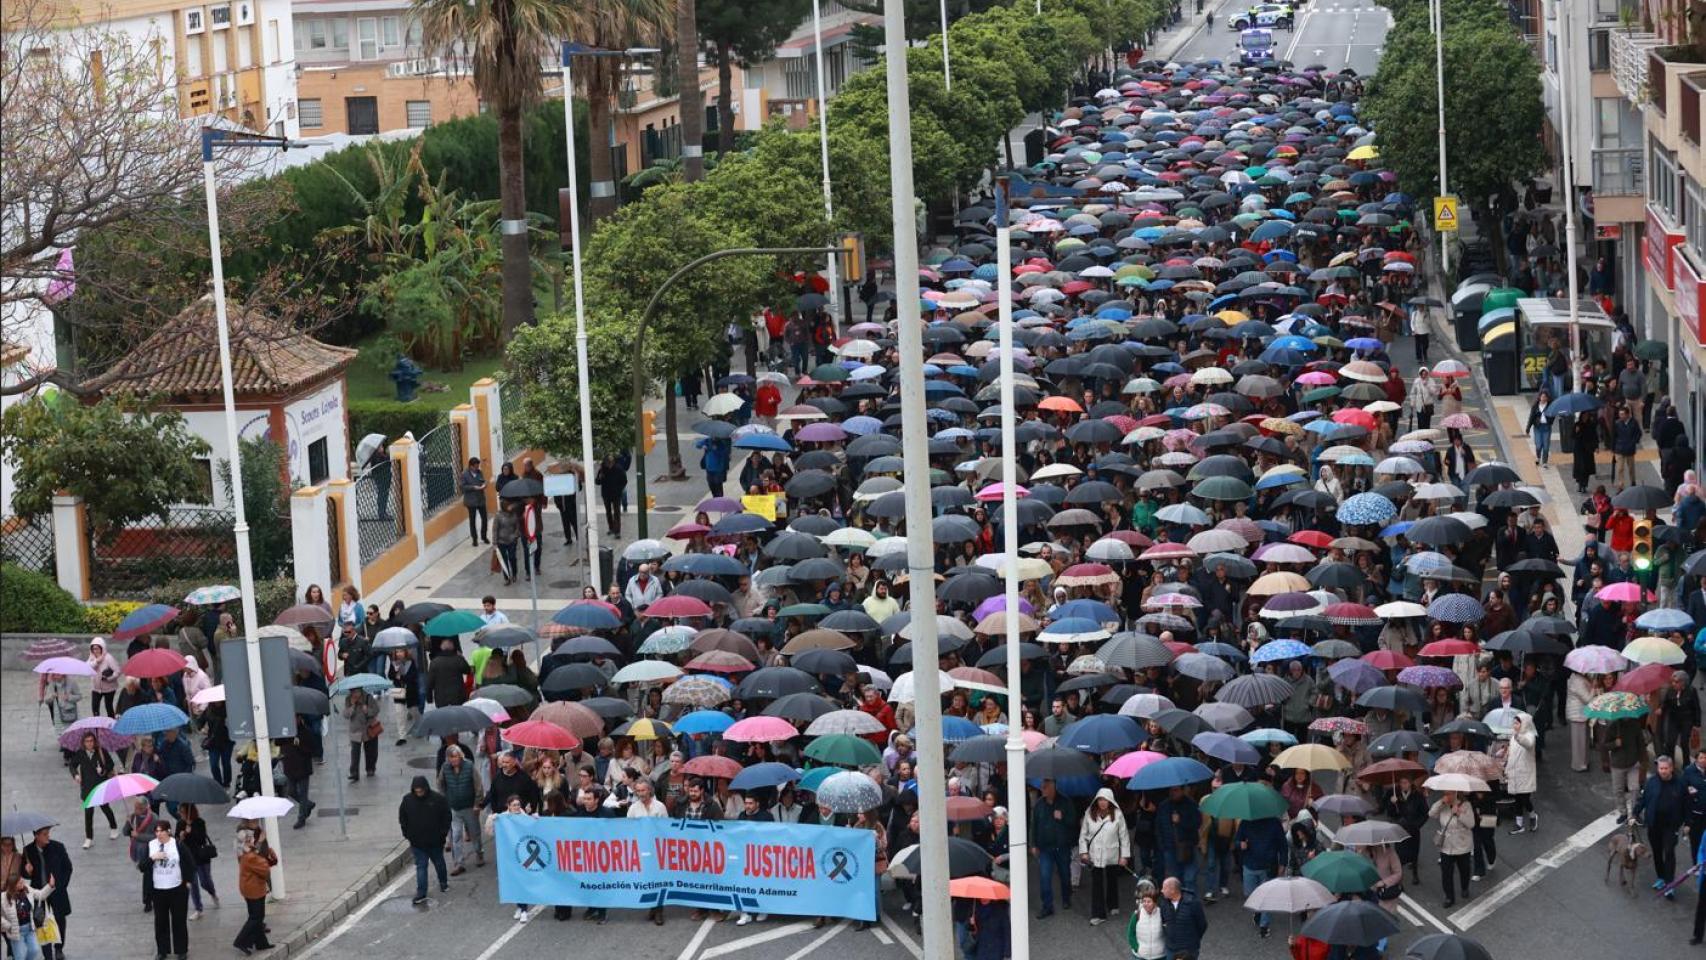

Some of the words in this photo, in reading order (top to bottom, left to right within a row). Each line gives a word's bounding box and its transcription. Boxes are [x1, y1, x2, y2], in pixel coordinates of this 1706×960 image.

[556, 839, 641, 873] MEMORIA
[655, 838, 725, 875] VERDAD
[744, 844, 816, 879] JUSTICIA
[581, 881, 631, 890] Asociación
[677, 880, 756, 894] Descarrilamiento
[758, 887, 797, 897] Adamuz
